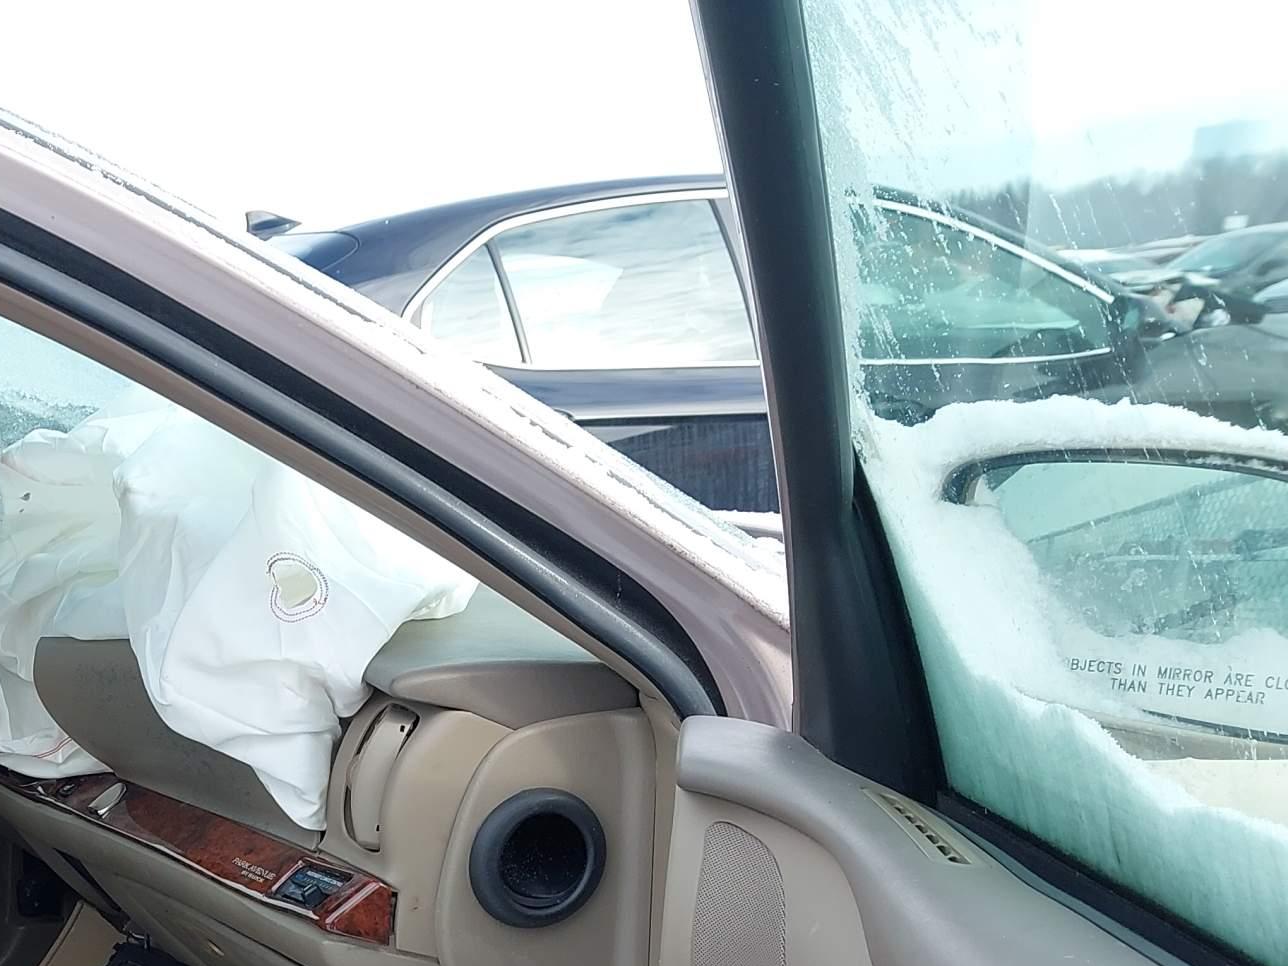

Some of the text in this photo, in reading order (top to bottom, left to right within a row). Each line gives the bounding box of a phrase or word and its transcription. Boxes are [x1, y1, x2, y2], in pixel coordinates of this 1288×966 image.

[1132, 663, 1147, 677] IN
[1157, 665, 1214, 684] MIRROR
[1223, 671, 1256, 687] ARE
[1110, 677, 1266, 705] THAN THEY APPEAR
